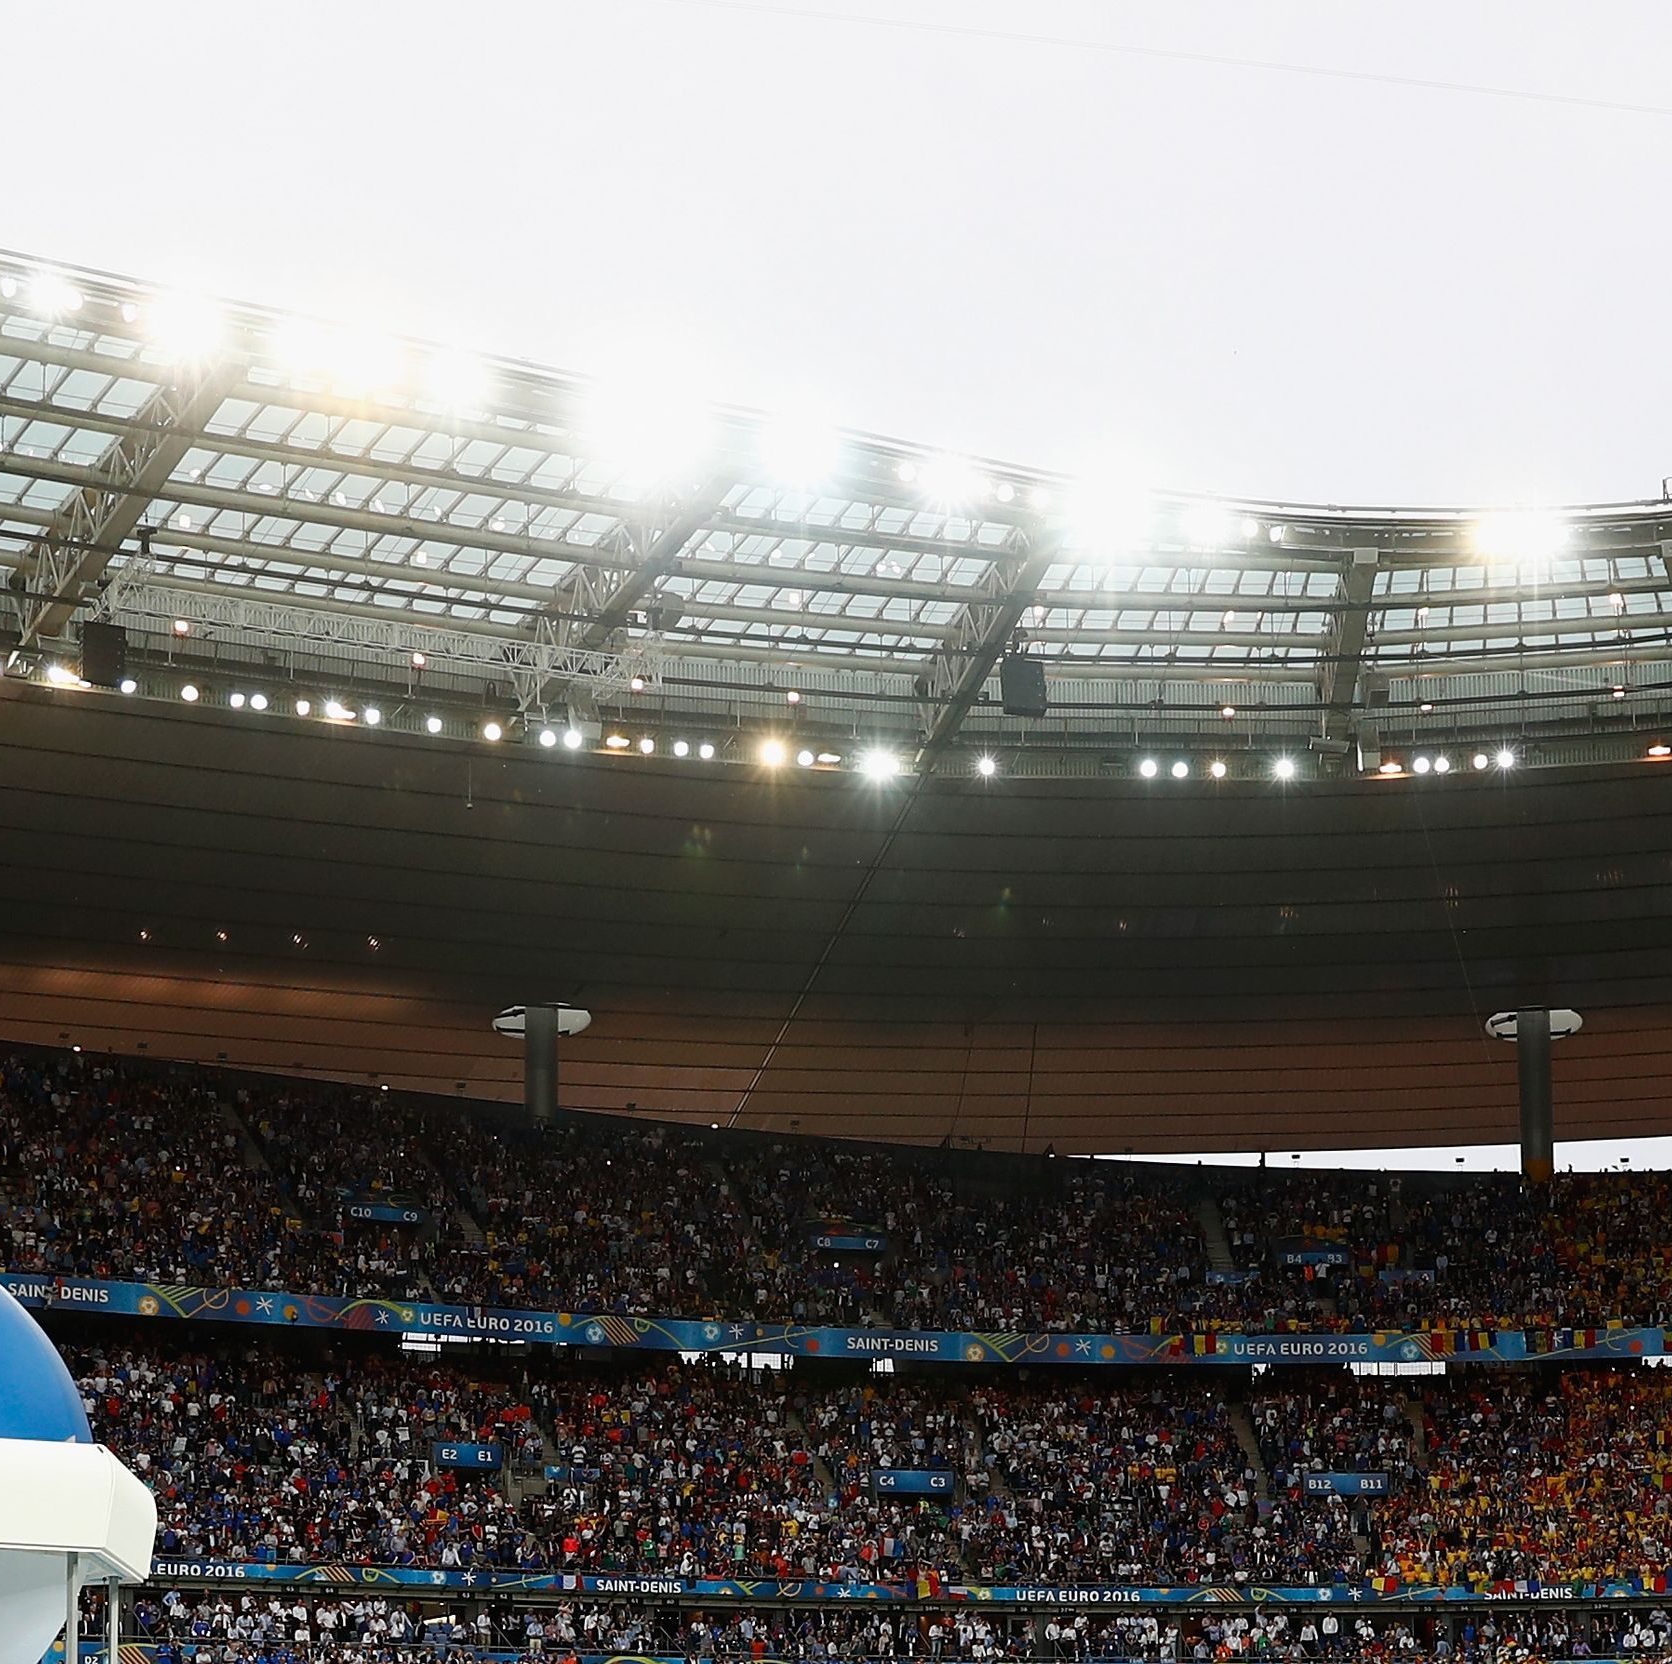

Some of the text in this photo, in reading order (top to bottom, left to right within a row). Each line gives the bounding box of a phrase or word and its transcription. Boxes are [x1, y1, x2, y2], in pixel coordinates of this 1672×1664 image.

[350, 1206, 419, 1222] C10 C9
[865, 1239, 880, 1250] C7
[1287, 1254, 1302, 1264] B4
[420, 1312, 554, 1334] UEFA EURO 2016
[847, 1337, 939, 1353] SAINT-DENIS
[1234, 1342, 1368, 1356] UEFA EURO 2016
[442, 1448, 492, 1462] E2 E1
[879, 1476, 946, 1488] C4 C3
[1308, 1479, 1383, 1490] B12 B11
[157, 1563, 201, 1577] EURO
[205, 1566, 246, 1578] 2016
[596, 1579, 682, 1594] SAINT-DENIS
[1016, 1590, 1141, 1602] UEFA EURO 2016
[84, 1656, 98, 1664] D2
